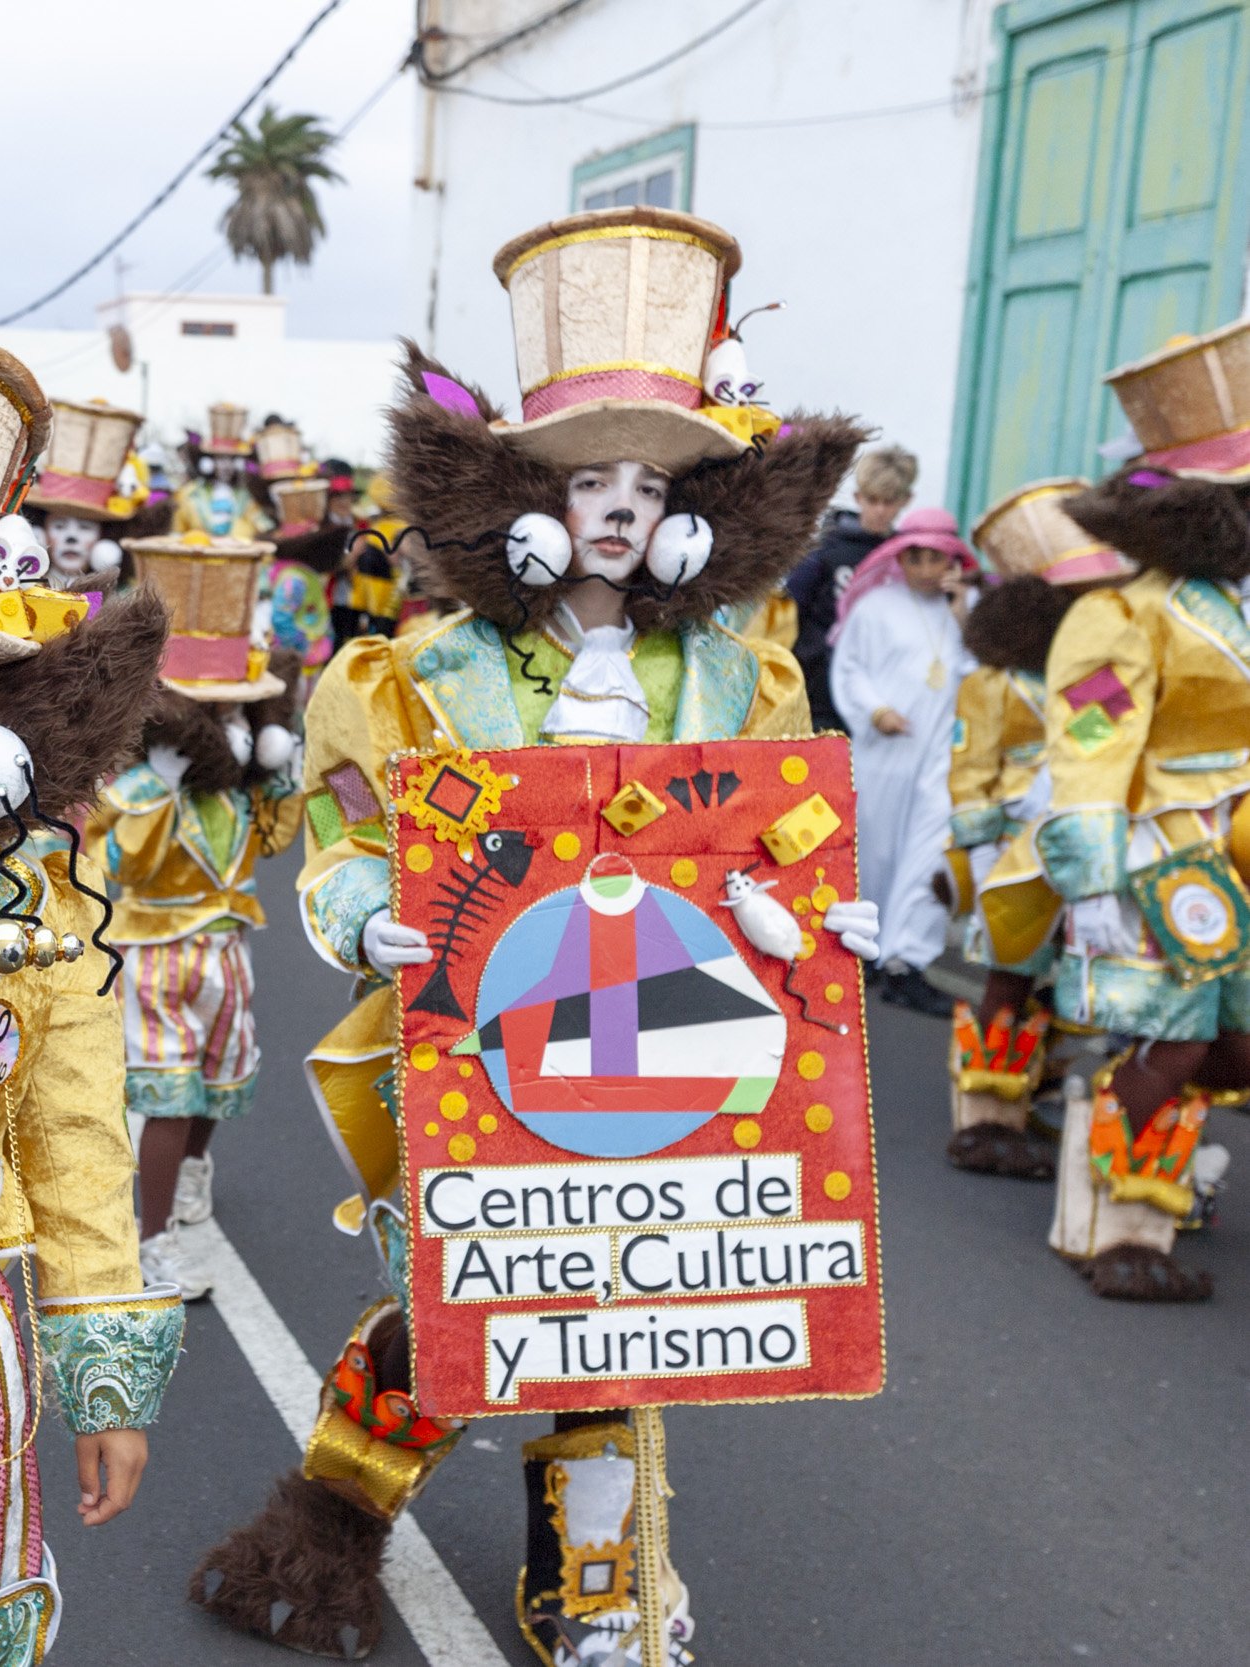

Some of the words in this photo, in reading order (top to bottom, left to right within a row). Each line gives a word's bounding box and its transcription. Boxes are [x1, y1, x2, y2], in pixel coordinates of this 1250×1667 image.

[423, 1172, 686, 1231] Centros
[714, 1160, 793, 1218] de
[450, 1240, 613, 1299] Arte,
[619, 1231, 863, 1294] Cultura
[491, 1336, 529, 1398] y
[538, 1314, 799, 1375] Turismo
